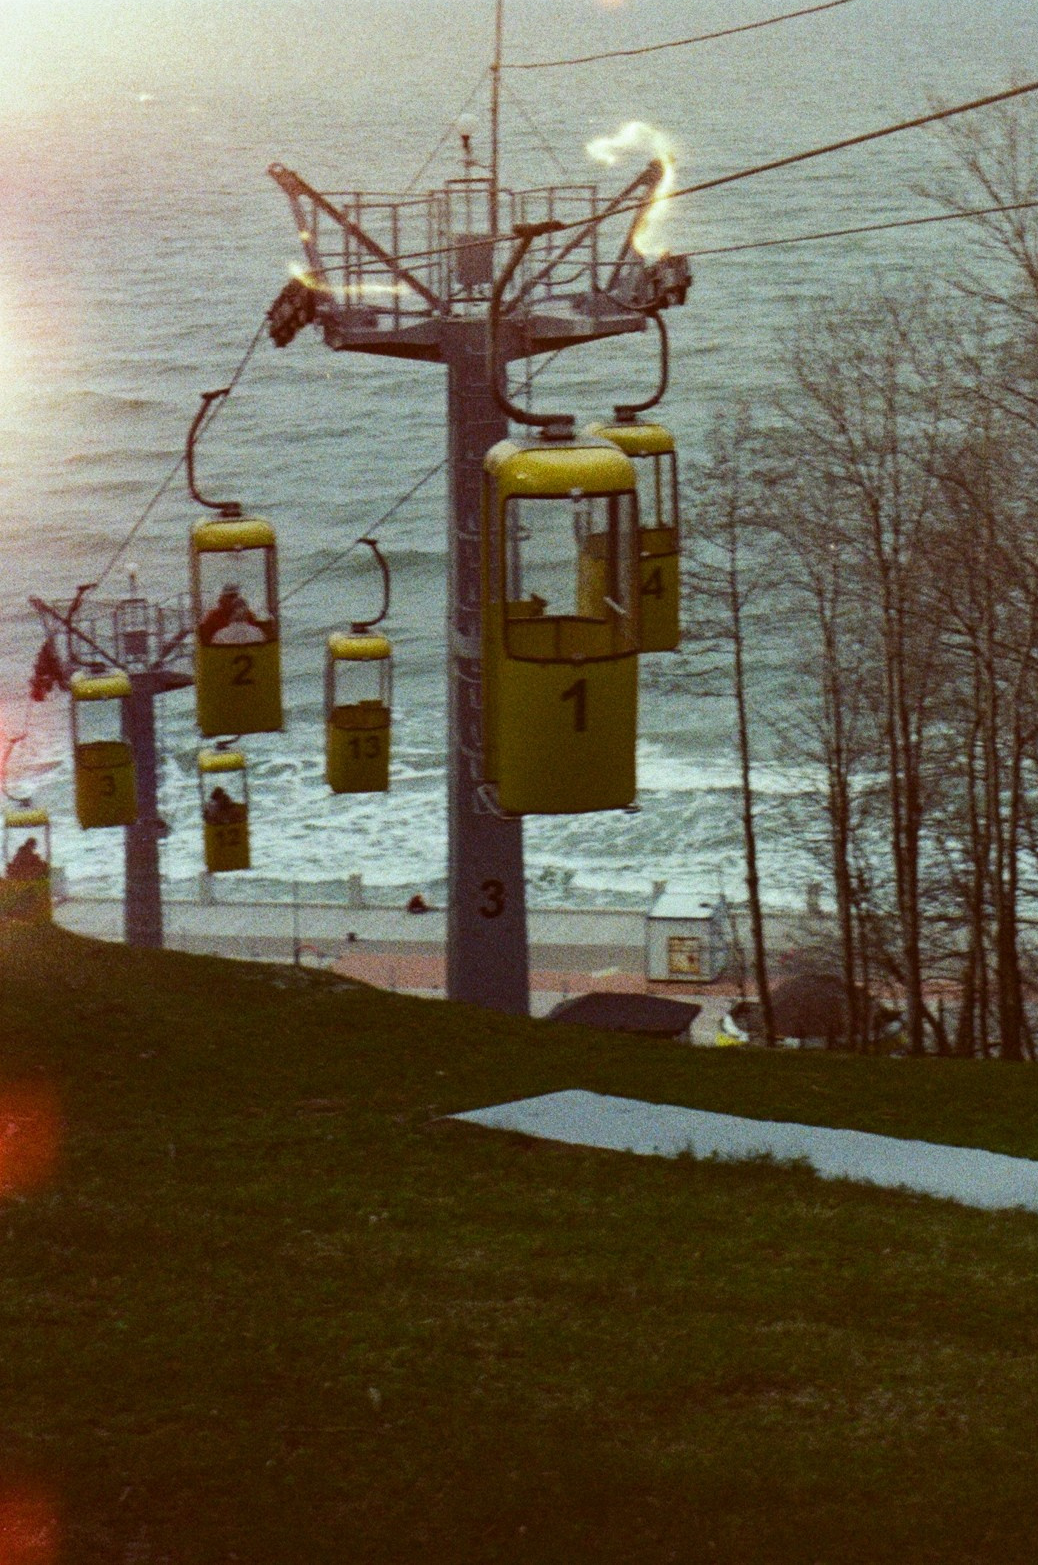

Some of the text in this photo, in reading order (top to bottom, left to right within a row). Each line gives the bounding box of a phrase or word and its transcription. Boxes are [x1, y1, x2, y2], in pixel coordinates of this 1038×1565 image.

[231, 654, 254, 686] 2
[561, 677, 587, 732] 1
[347, 735, 381, 759] 13
[100, 775, 116, 796] 3
[480, 879, 505, 919] 3
